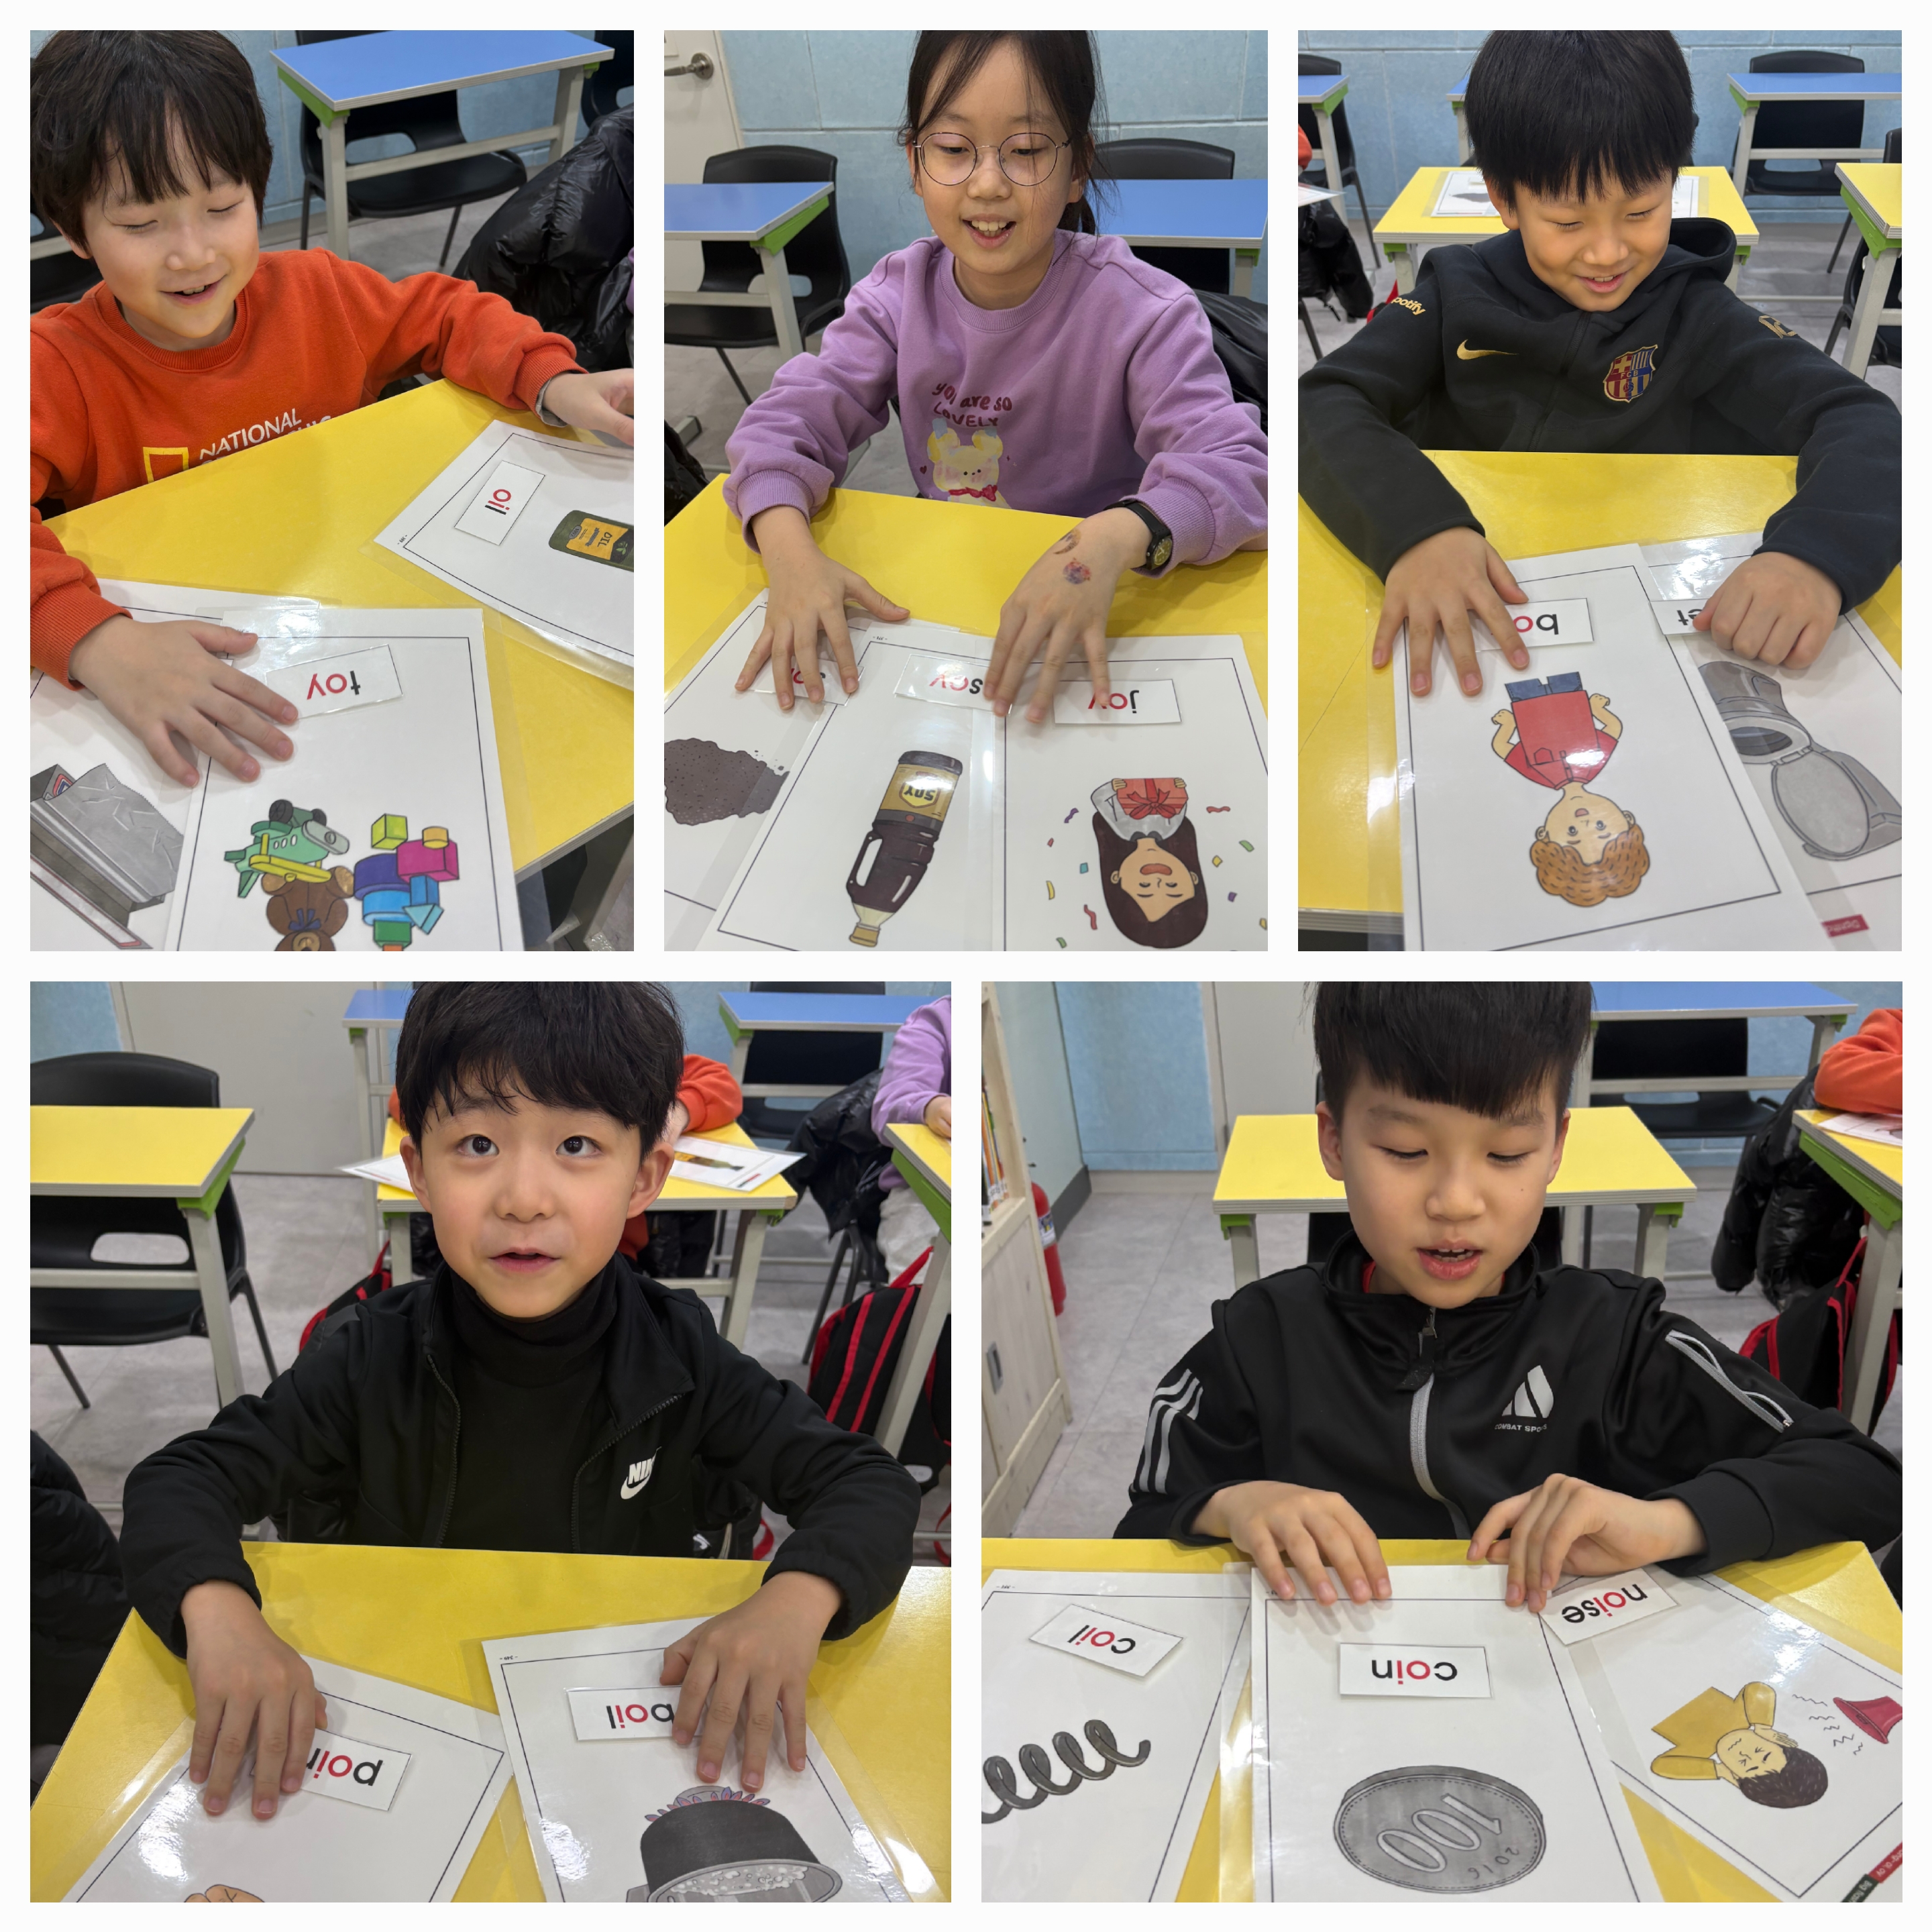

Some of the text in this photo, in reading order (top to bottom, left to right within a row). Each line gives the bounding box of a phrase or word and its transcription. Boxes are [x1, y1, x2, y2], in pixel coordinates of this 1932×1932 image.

[1391, 296, 1426, 315] potify
[1620, 370, 1638, 380] FCB
[933, 401, 998, 427] LOVELY
[960, 395, 991, 411] are
[994, 396, 1012, 411] so
[199, 408, 302, 460] NATIONAL
[484, 489, 511, 515] oil
[597, 532, 612, 547] OIL
[1512, 612, 1559, 636] bo
[307, 670, 361, 700] toy
[929, 674, 983, 694] soy
[1561, 1584, 1648, 1623] noise
[1067, 1625, 1136, 1654] coil
[1371, 1660, 1458, 1684] coin
[606, 1703, 674, 1729] boil
[1376, 1792, 1502, 1873] 100
[1467, 1847, 1519, 1879] 2016
